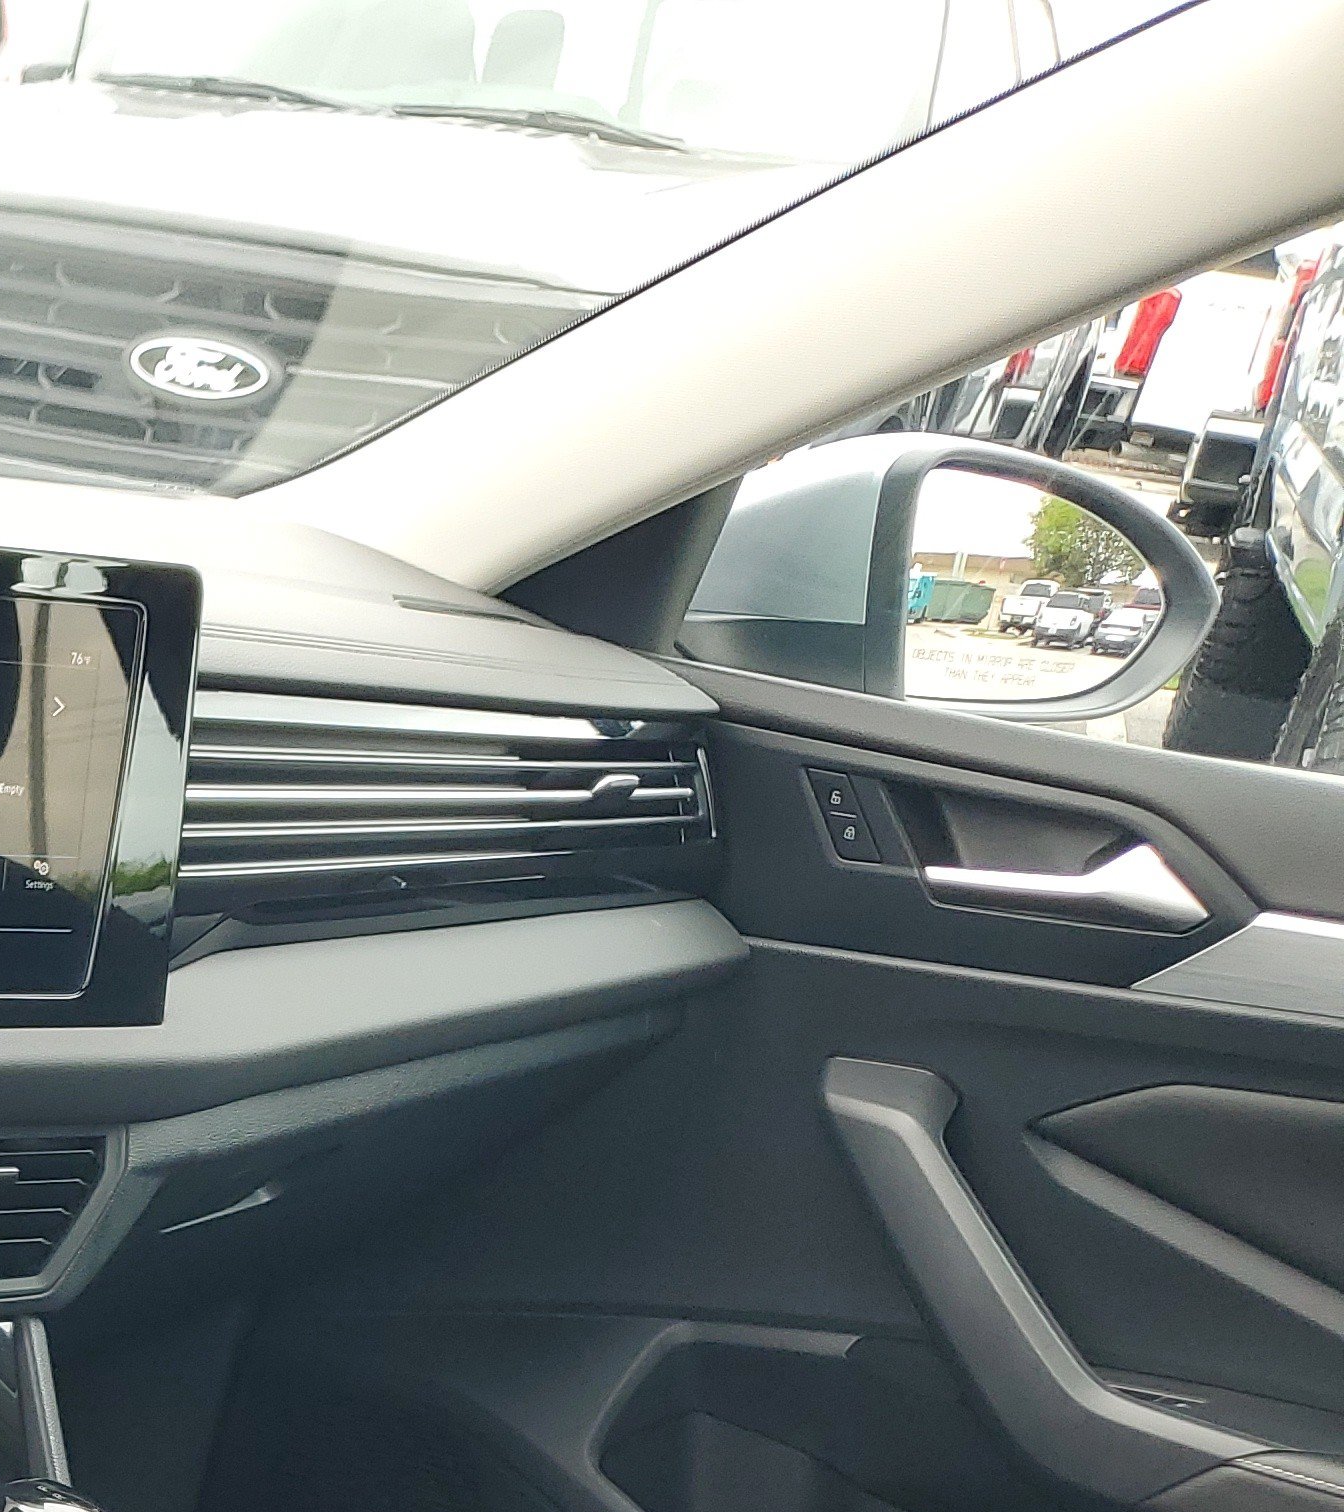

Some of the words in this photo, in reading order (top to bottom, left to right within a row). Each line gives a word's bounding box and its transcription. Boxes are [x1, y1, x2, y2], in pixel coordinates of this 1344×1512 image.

[154, 346, 244, 392] Ford
[0, 783, 25, 796] Empty
[25, 879, 54, 891] Settings
